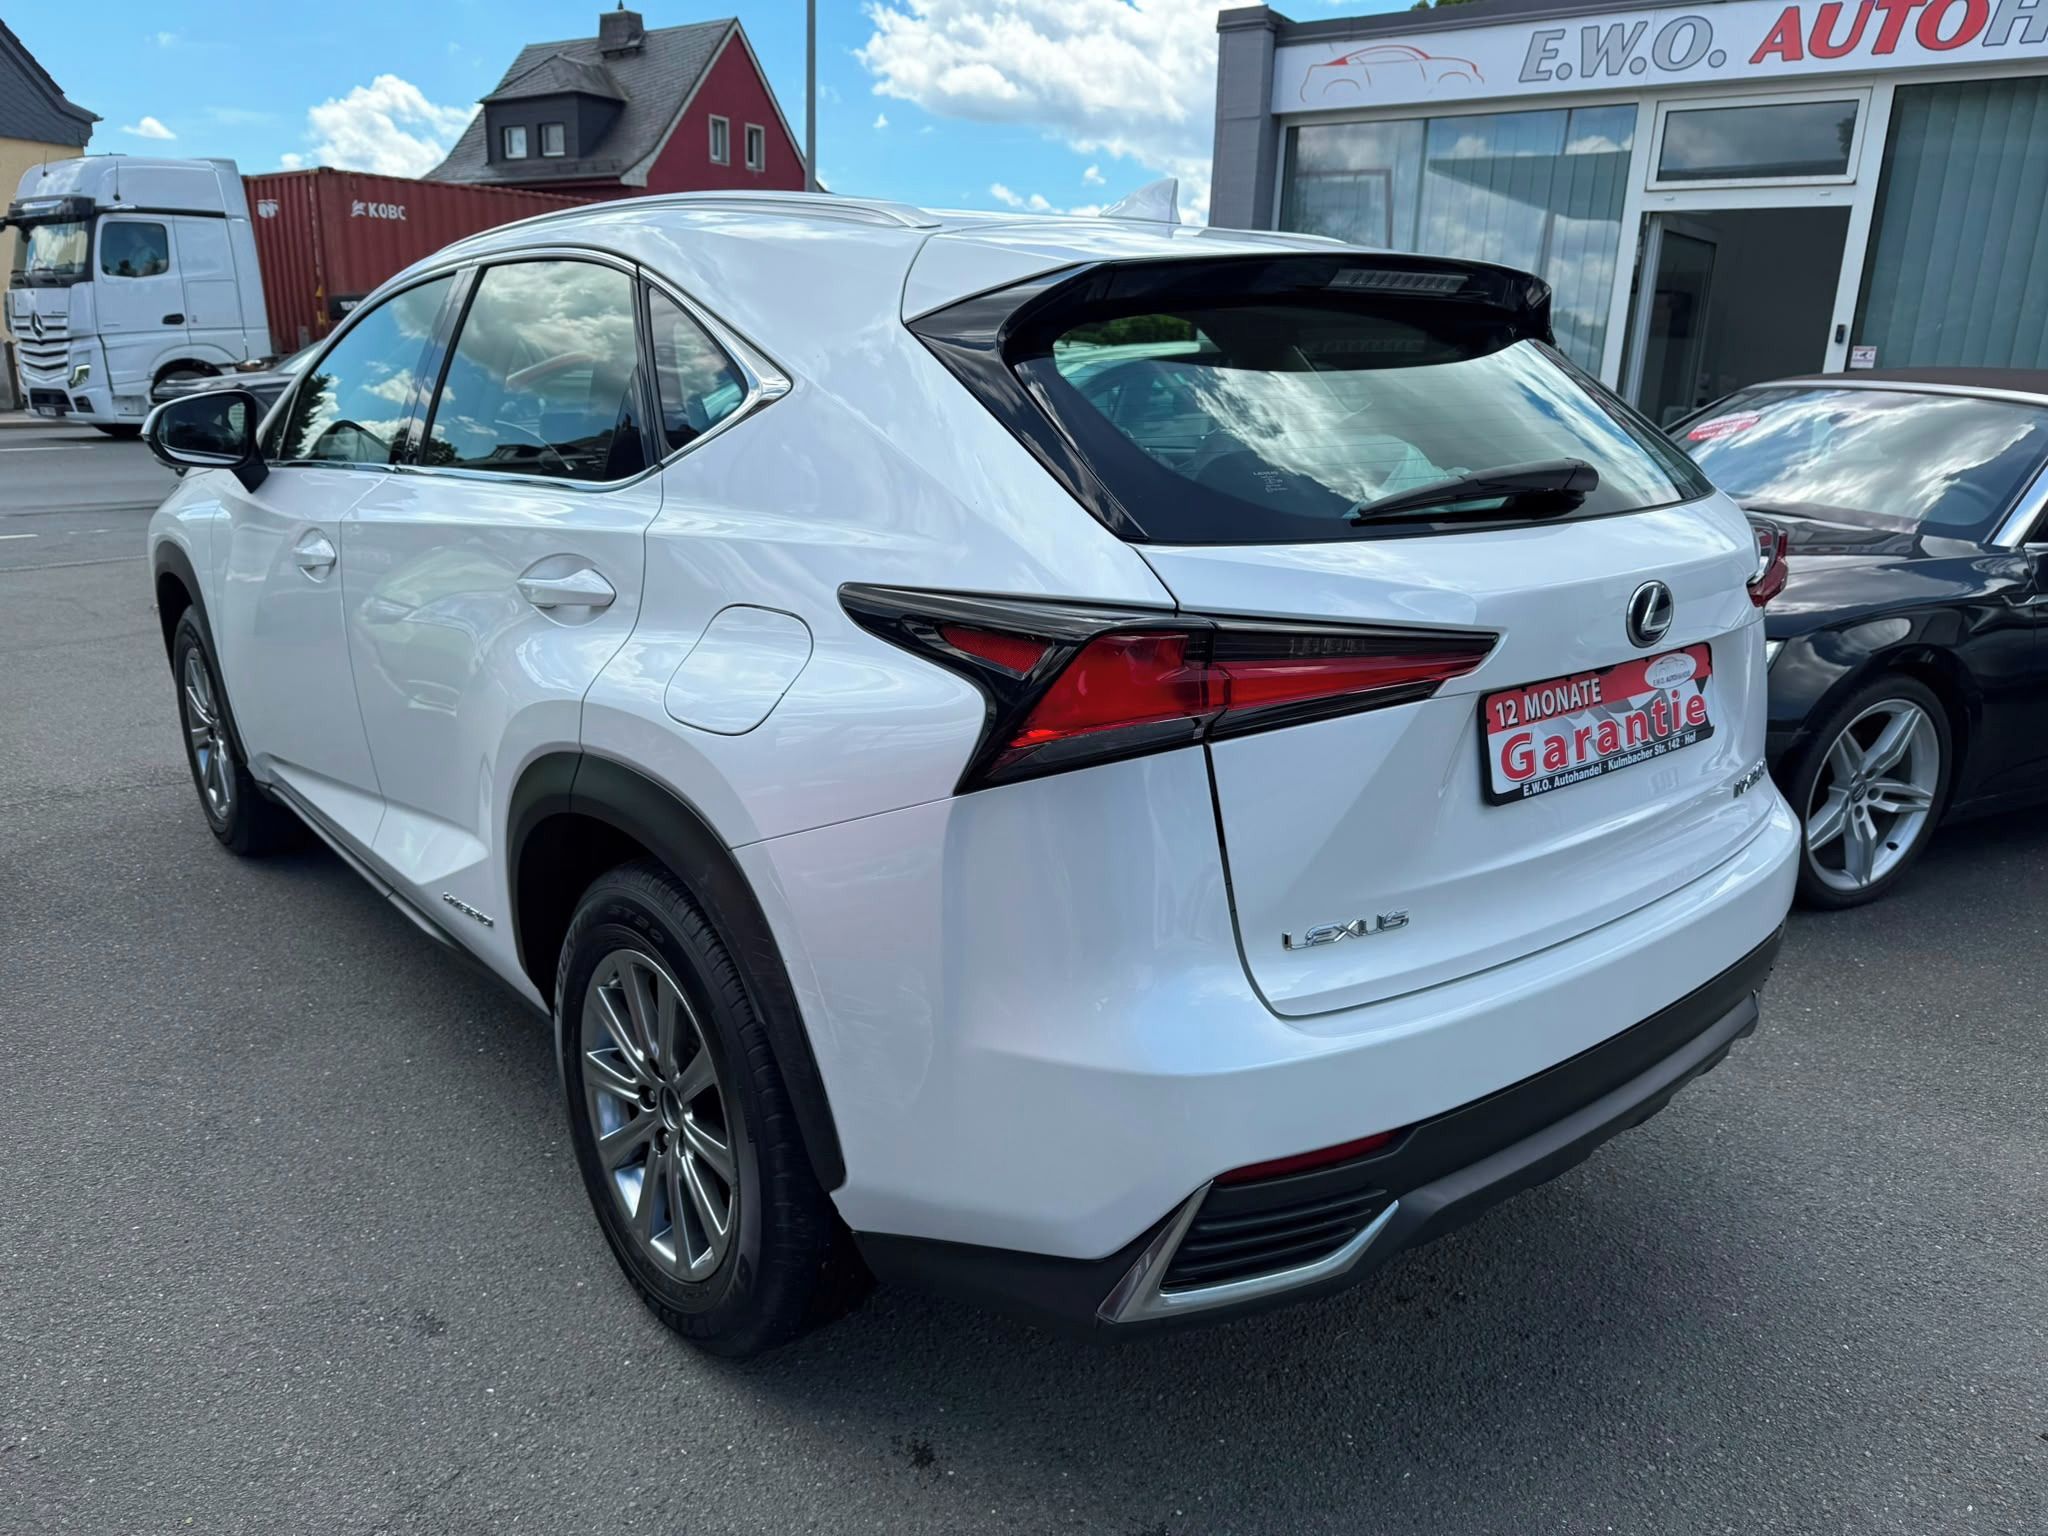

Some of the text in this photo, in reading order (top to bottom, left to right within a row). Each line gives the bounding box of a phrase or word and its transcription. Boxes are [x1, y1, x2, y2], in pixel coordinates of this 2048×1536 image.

[1518, 16, 1727, 83] E.W.O.
[1495, 678, 1602, 727] 12 MONATE
[1500, 689, 1706, 781] Garantie
[1523, 733, 1697, 797] E.W.O. Autohandel Kulmbacher Str. 142 Hof
[1281, 908, 1410, 951] LEXUS
